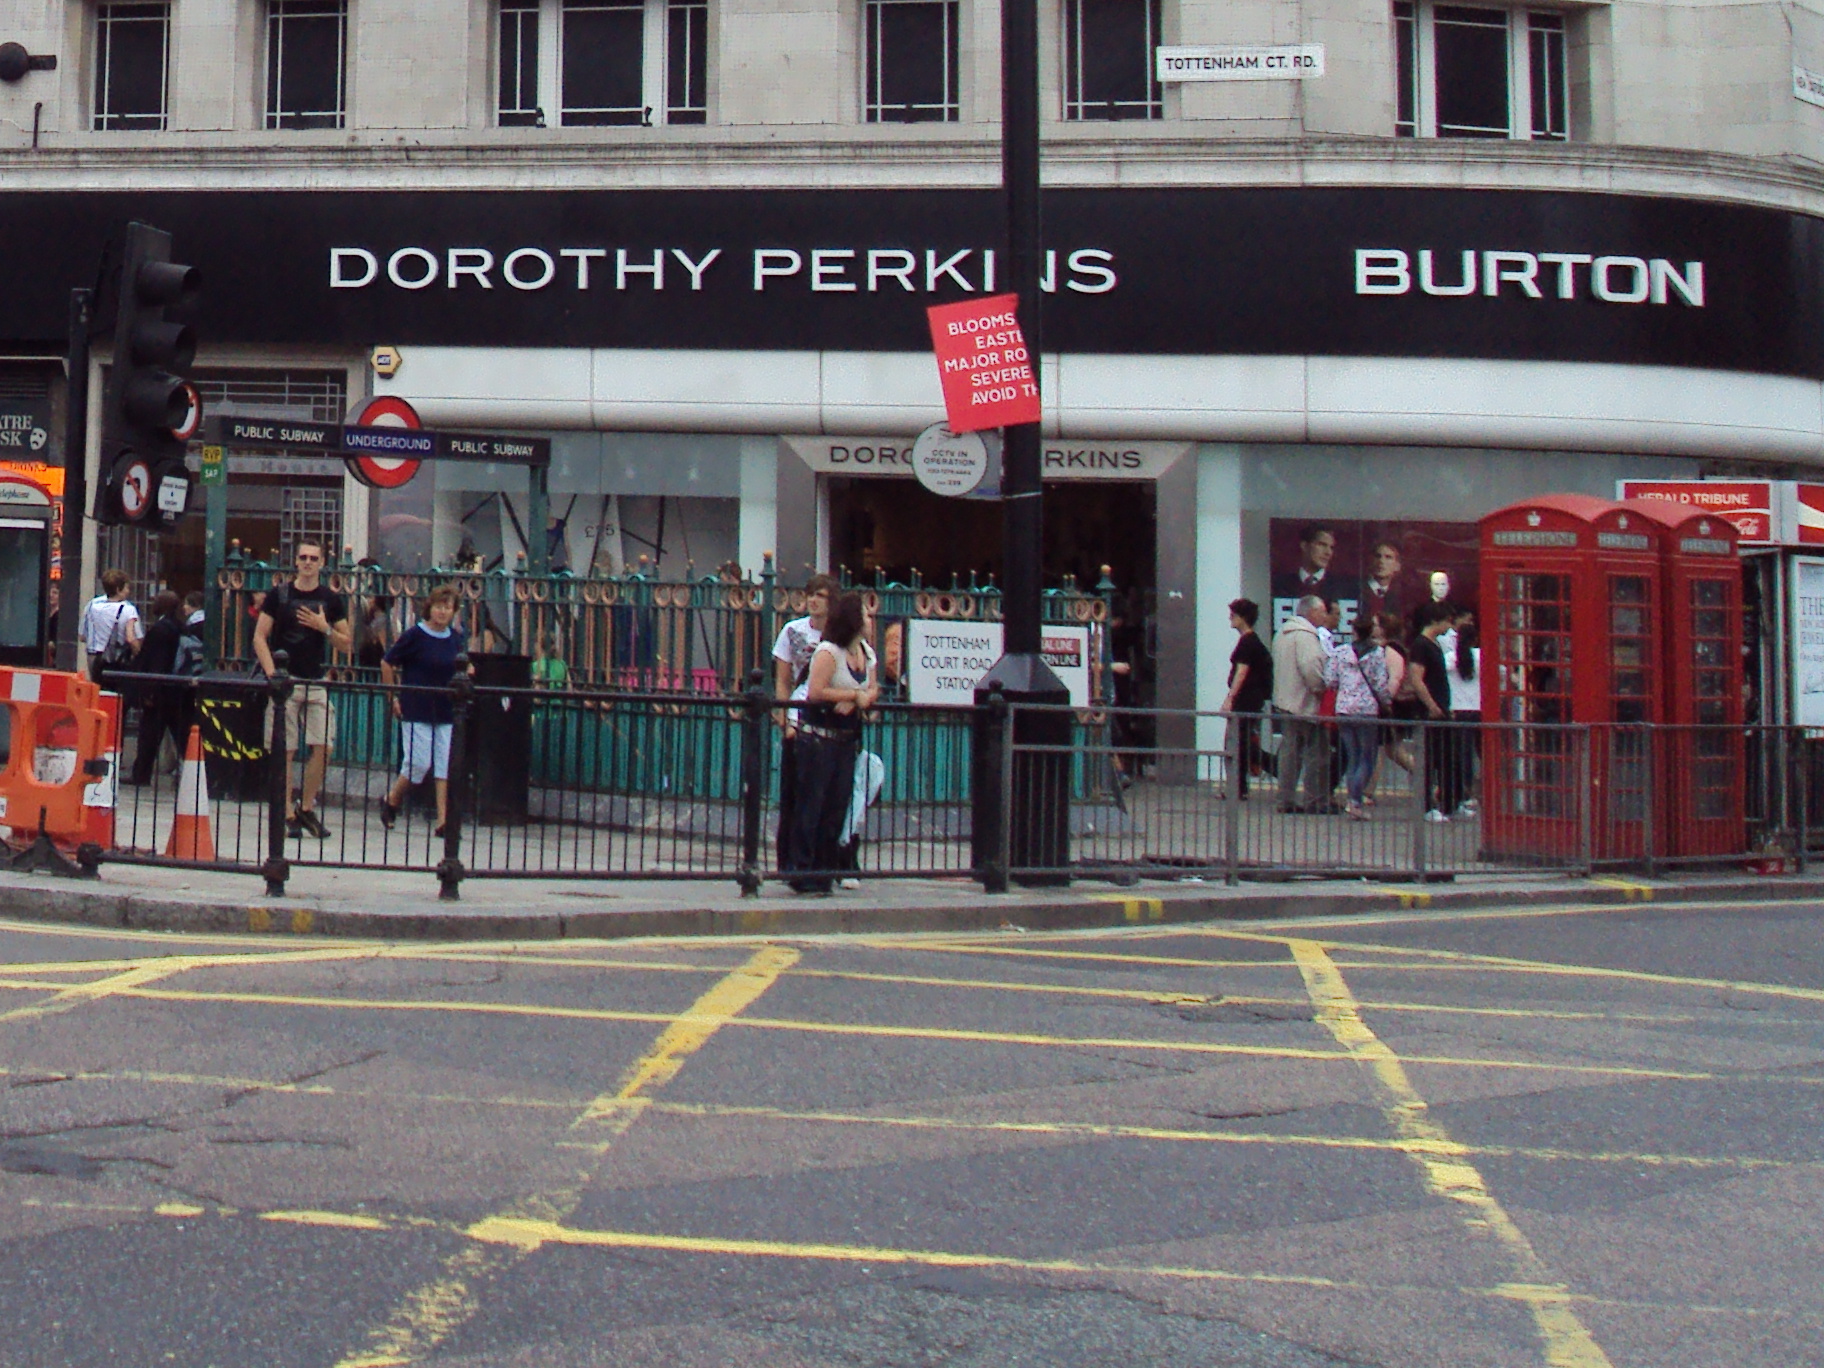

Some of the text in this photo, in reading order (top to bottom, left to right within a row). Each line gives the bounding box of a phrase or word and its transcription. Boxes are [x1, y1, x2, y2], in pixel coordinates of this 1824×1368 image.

[1165, 56, 1258, 70] TOTTENHAM
[329, 247, 722, 290] DOROTHY
[1355, 249, 1705, 307] BURTON
[944, 352, 1000, 373] MAJOR
[970, 365, 1032, 387] SEVERE
[971, 386, 1016, 405] AVOID
[234, 425, 326, 443] PUBLIC SUBWAY
[346, 434, 432, 451] UNDERGROUND
[451, 440, 535, 457] PUBLIC SUBWAY
[1693, 492, 1749, 505] TRIBUNE
[924, 635, 990, 650] TOTTENHAM
[921, 655, 993, 671] COURT ROAD
[1061, 654, 1078, 666] LINE
[936, 676, 978, 690] STATION
